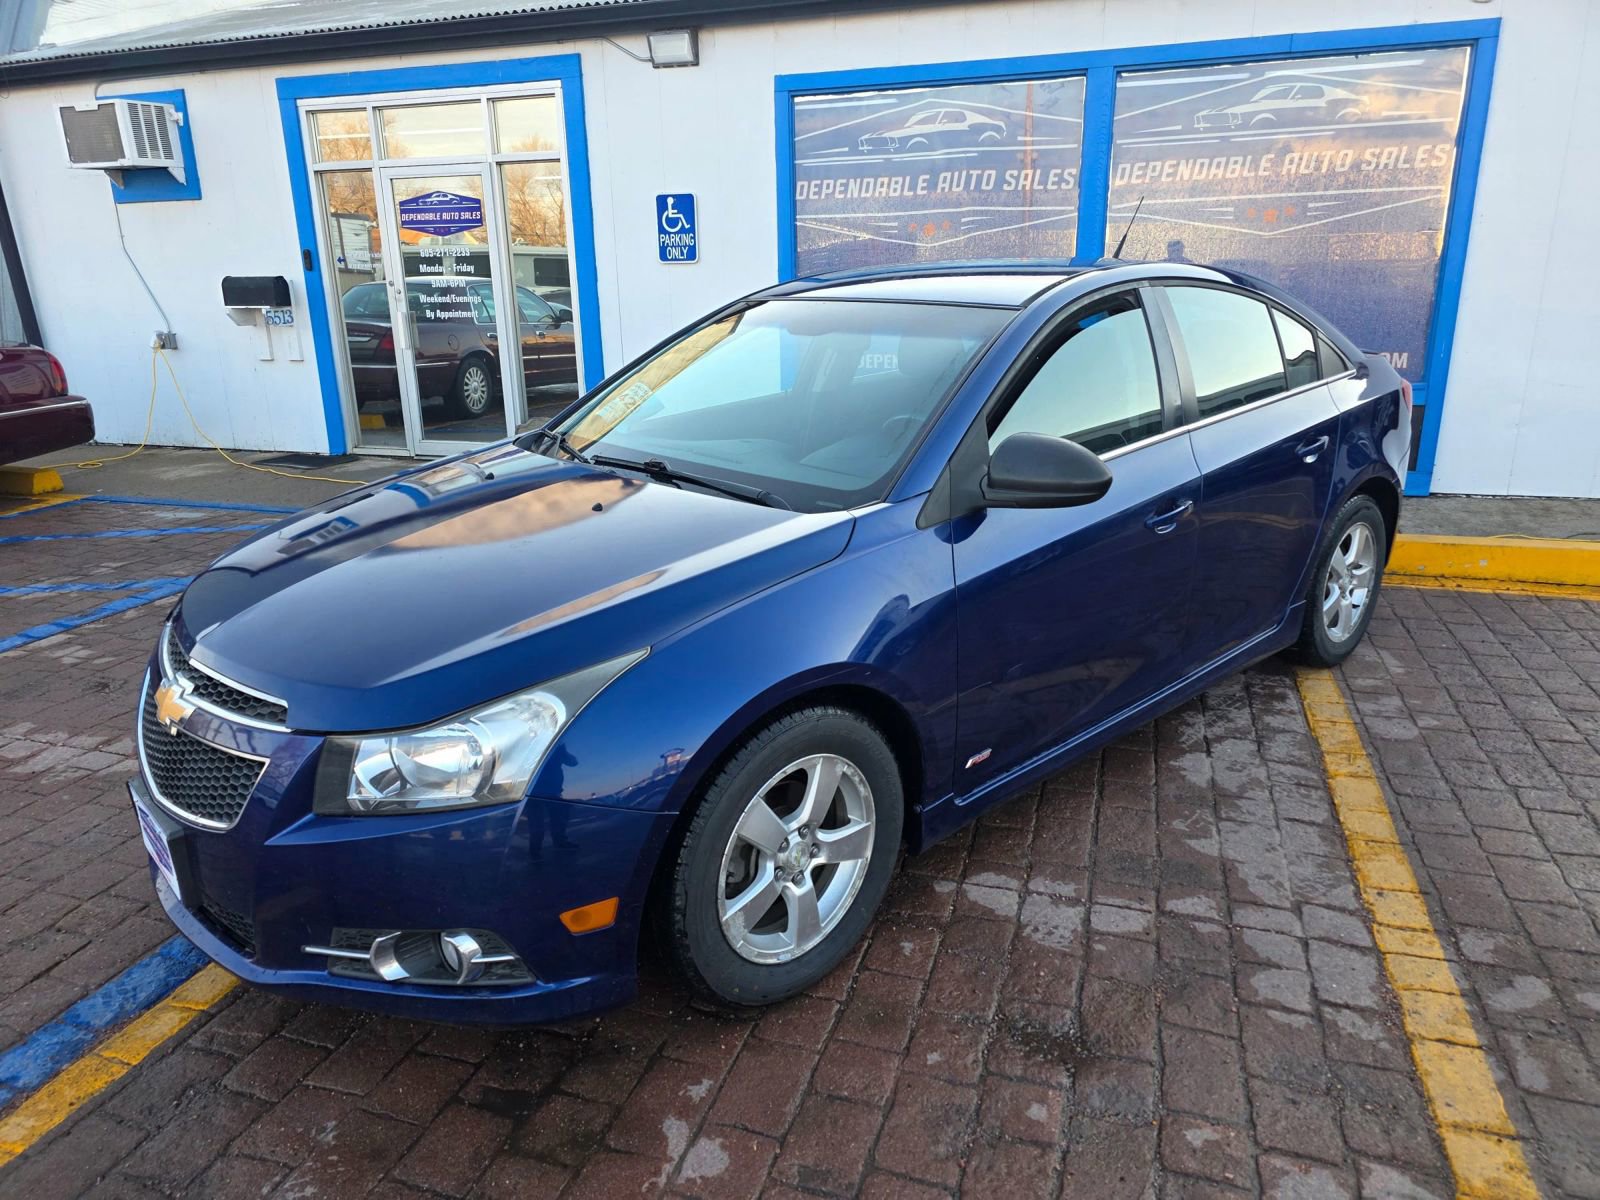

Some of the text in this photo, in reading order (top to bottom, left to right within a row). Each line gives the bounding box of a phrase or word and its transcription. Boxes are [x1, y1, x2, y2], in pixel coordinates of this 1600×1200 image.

[1115, 143, 1451, 185] DEPENDABLE AUTO SALES
[796, 167, 1077, 199] DEPENDABLE AUTO SALES
[402, 213, 441, 221] DEPENDABLE
[442, 212, 459, 220] AUTO
[660, 234, 694, 246] PARKING
[667, 247, 688, 259] ONLY
[419, 263, 446, 274] Monday
[453, 263, 475, 274] Friday
[419, 294, 482, 304] Weekend/Evenings
[265, 309, 295, 326] 5513
[426, 309, 478, 319] By Appointment
